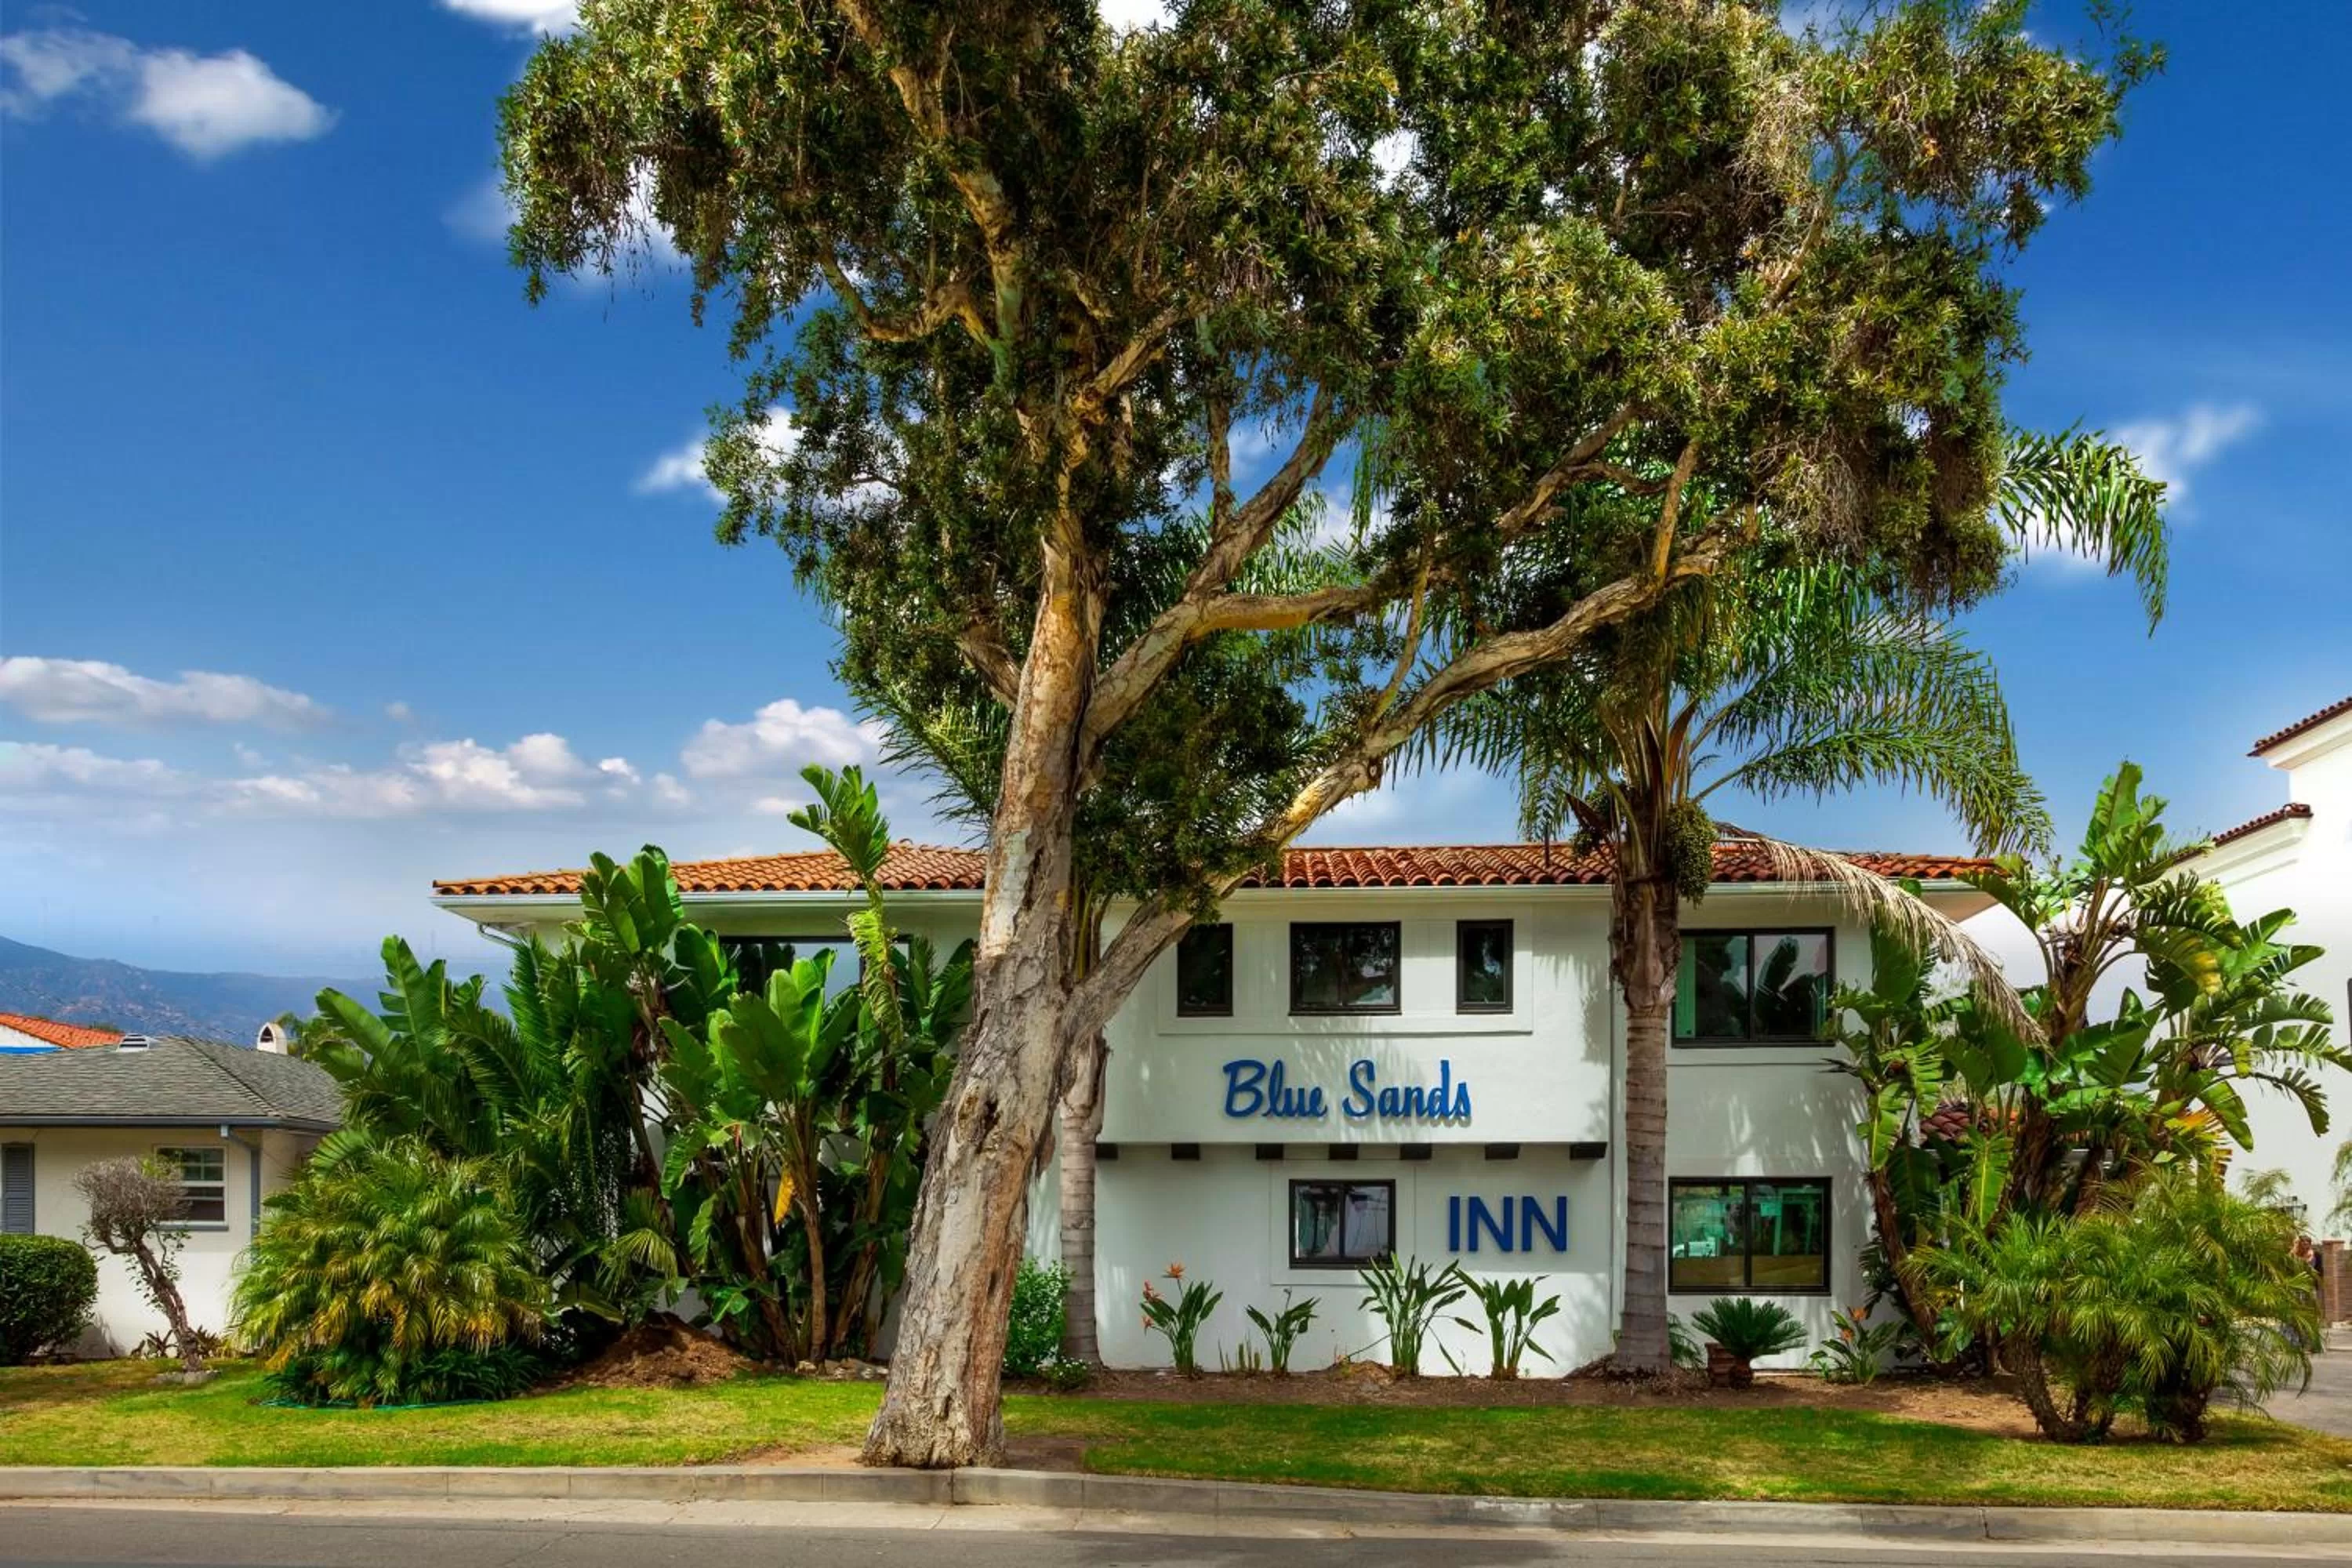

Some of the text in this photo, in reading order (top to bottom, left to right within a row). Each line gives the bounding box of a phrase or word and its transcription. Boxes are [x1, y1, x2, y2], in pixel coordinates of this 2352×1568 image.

[1222, 1059, 1472, 1117] Blue Sands
[1449, 1196, 1567, 1252] INN
